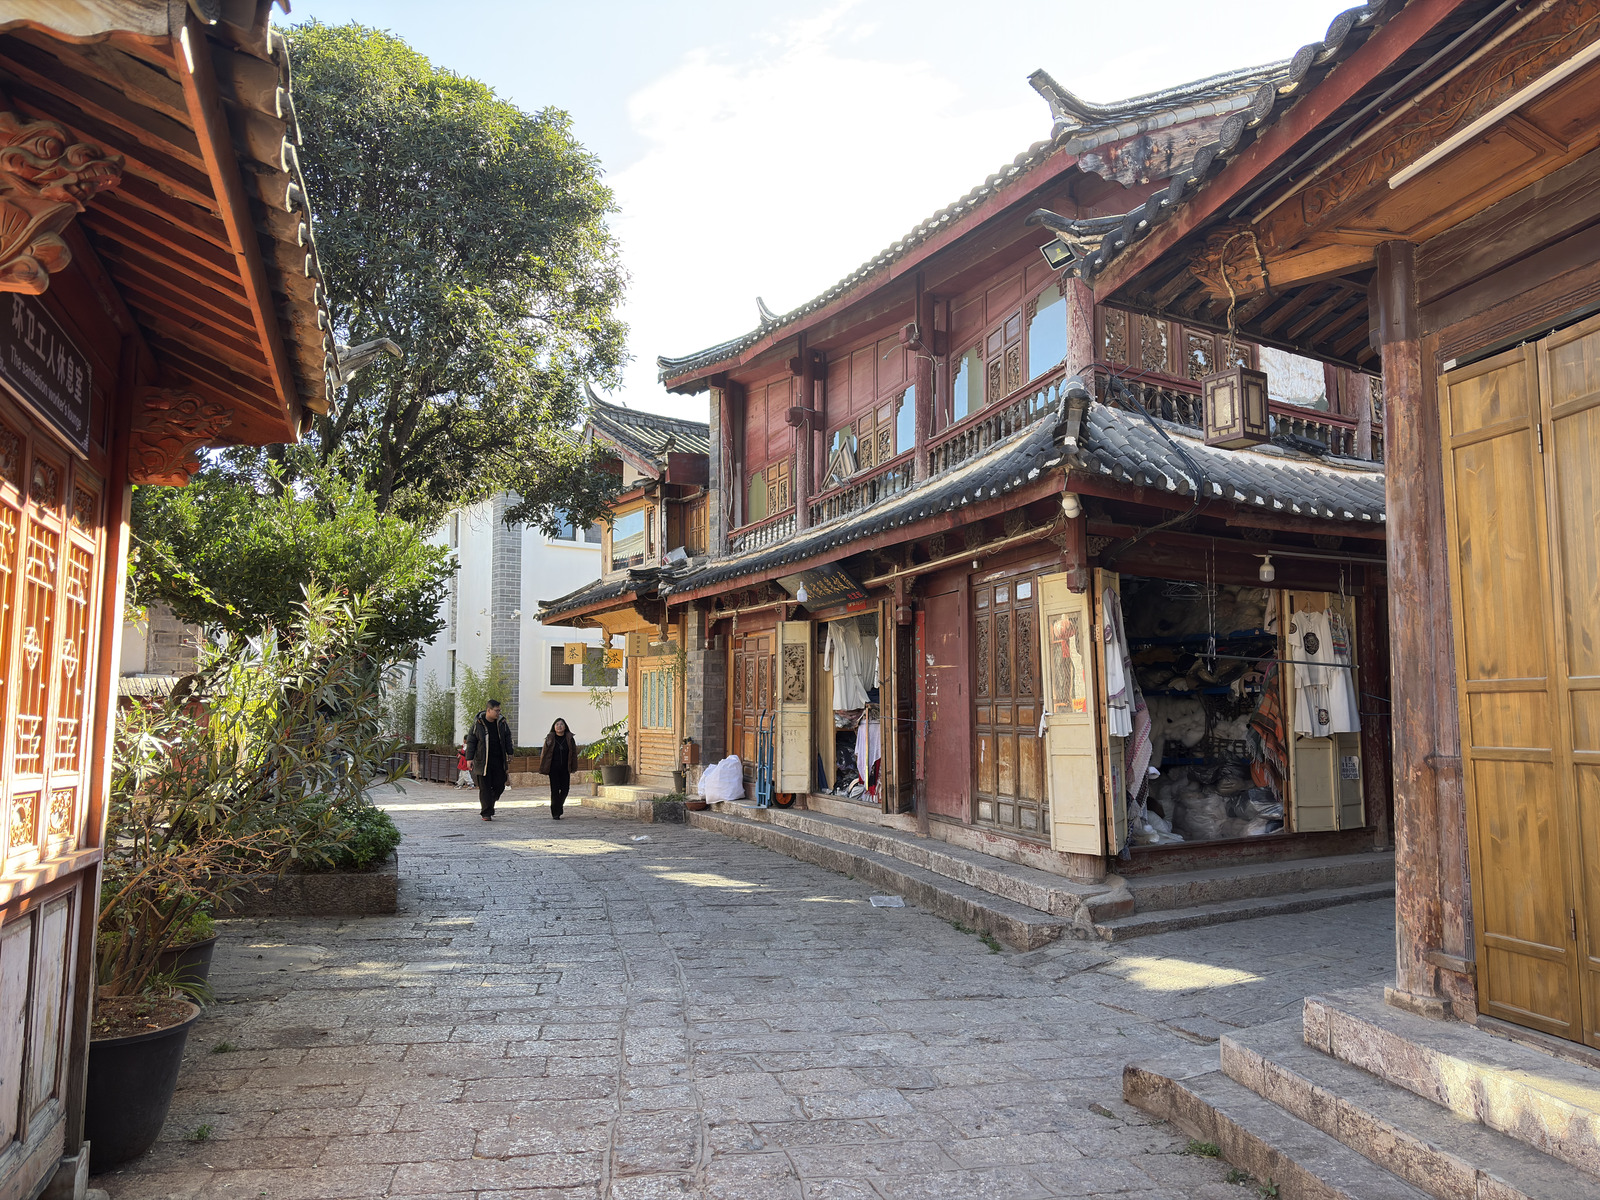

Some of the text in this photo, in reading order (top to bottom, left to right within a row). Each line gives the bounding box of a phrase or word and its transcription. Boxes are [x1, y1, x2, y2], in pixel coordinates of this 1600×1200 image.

[12, 292, 83, 405] 环卫工人休息室
[10, 344, 82, 431] The sanitation worker's lounge
[568, 646, 579, 659] 茶
[611, 652, 620, 664] 茶
